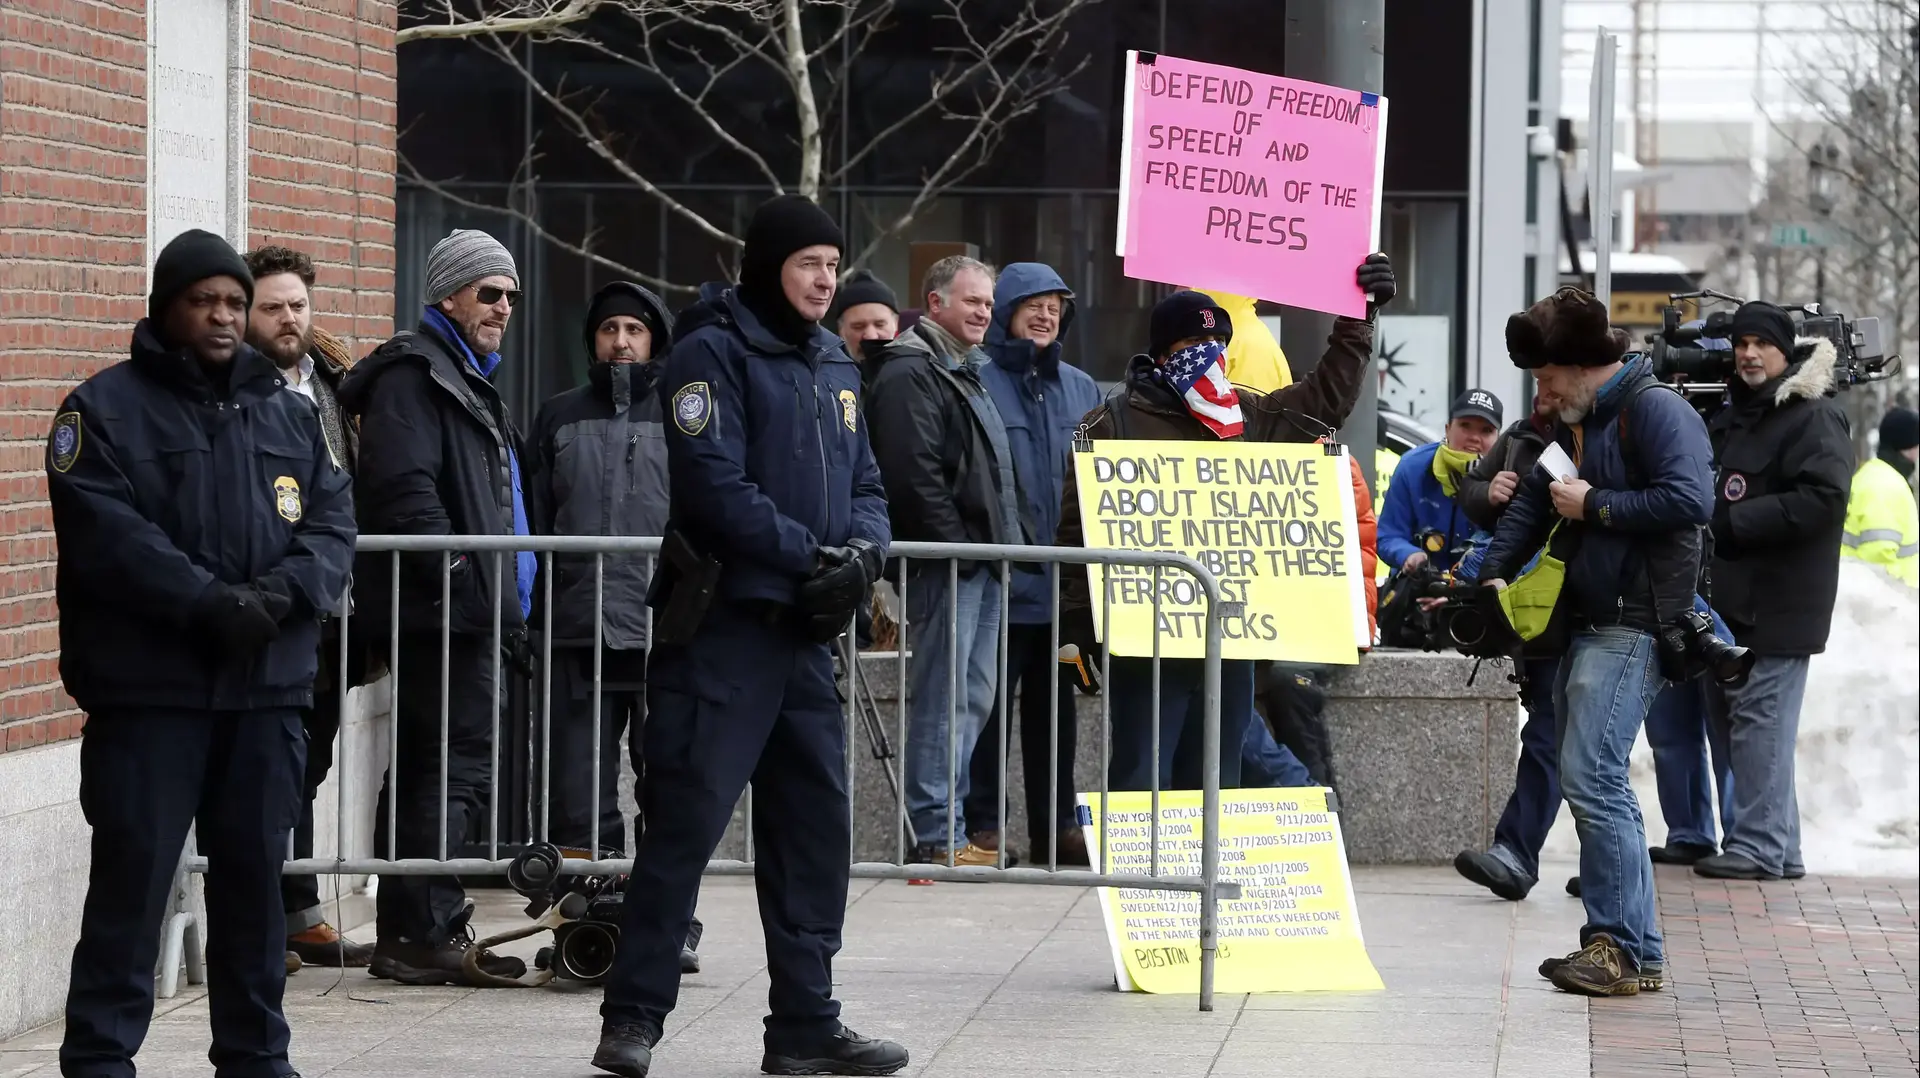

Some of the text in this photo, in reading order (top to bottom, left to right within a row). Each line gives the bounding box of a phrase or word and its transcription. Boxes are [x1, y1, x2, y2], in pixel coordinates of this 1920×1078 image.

[1151, 70, 1362, 125] DEFEND FREEDOM
[1233, 111, 1262, 135] OF
[1148, 125, 1309, 162] SPEECH AND
[1146, 161, 1357, 208] FREEDOM OF THE
[1206, 206, 1308, 250] PRESS
[1199, 309, 1215, 328] B
[677, 385, 704, 401] POLICE
[1470, 392, 1493, 407] DEA
[1093, 453, 1319, 486] DON'T BE NAIVE
[1097, 487, 1319, 518] ABOUT ISLAM'S
[1100, 519, 1345, 548] TRUE INTENTIONS
[1264, 549, 1347, 577] THESE
[1104, 577, 1251, 606] TERRORST
[1157, 612, 1278, 640] ATTCKS
[1107, 812, 1128, 823] NEW
[1131, 812, 1159, 823] YOR
[1222, 803, 1275, 814] 2/26/1993
[1276, 801, 1298, 811] AND
[1275, 813, 1328, 826] 9/11/2001
[1108, 824, 1192, 838] SPAIN 3/1/2004
[1110, 841, 1152, 852] LONDON
[1182, 838, 1229, 850] ENGND
[1233, 835, 1279, 848] 7/7/2005
[1280, 831, 1333, 845] 5/22/2013
[1112, 854, 1153, 865] MUNBA
[1157, 853, 1185, 864] NDIA
[1112, 866, 1168, 876] INDONEIA
[1234, 866, 1256, 876] AND
[1257, 862, 1309, 876] 10/1/2005
[1263, 876, 1286, 887] 2014
[1119, 889, 1155, 900] RUSSIA
[1156, 890, 1192, 901] 9/1999
[1246, 888, 1287, 899] NIGERIA
[1288, 885, 1322, 897] 4/2014
[1228, 902, 1261, 912] KENYA
[1261, 899, 1296, 911] 9/2013
[1126, 918, 1143, 928] ALL
[1145, 918, 1176, 928] THESE
[1237, 914, 1281, 925] ATTACKS
[1283, 912, 1312, 923] WERE
[1312, 911, 1341, 922] DONE
[1127, 931, 1139, 941] IN
[1140, 930, 1160, 940] THE
[1163, 929, 1196, 940] NAME
[1217, 927, 1244, 938] SLAM
[1248, 926, 1269, 937] AND
[1274, 925, 1329, 937] COUNTING
[1134, 946, 1190, 969] BOSTON
